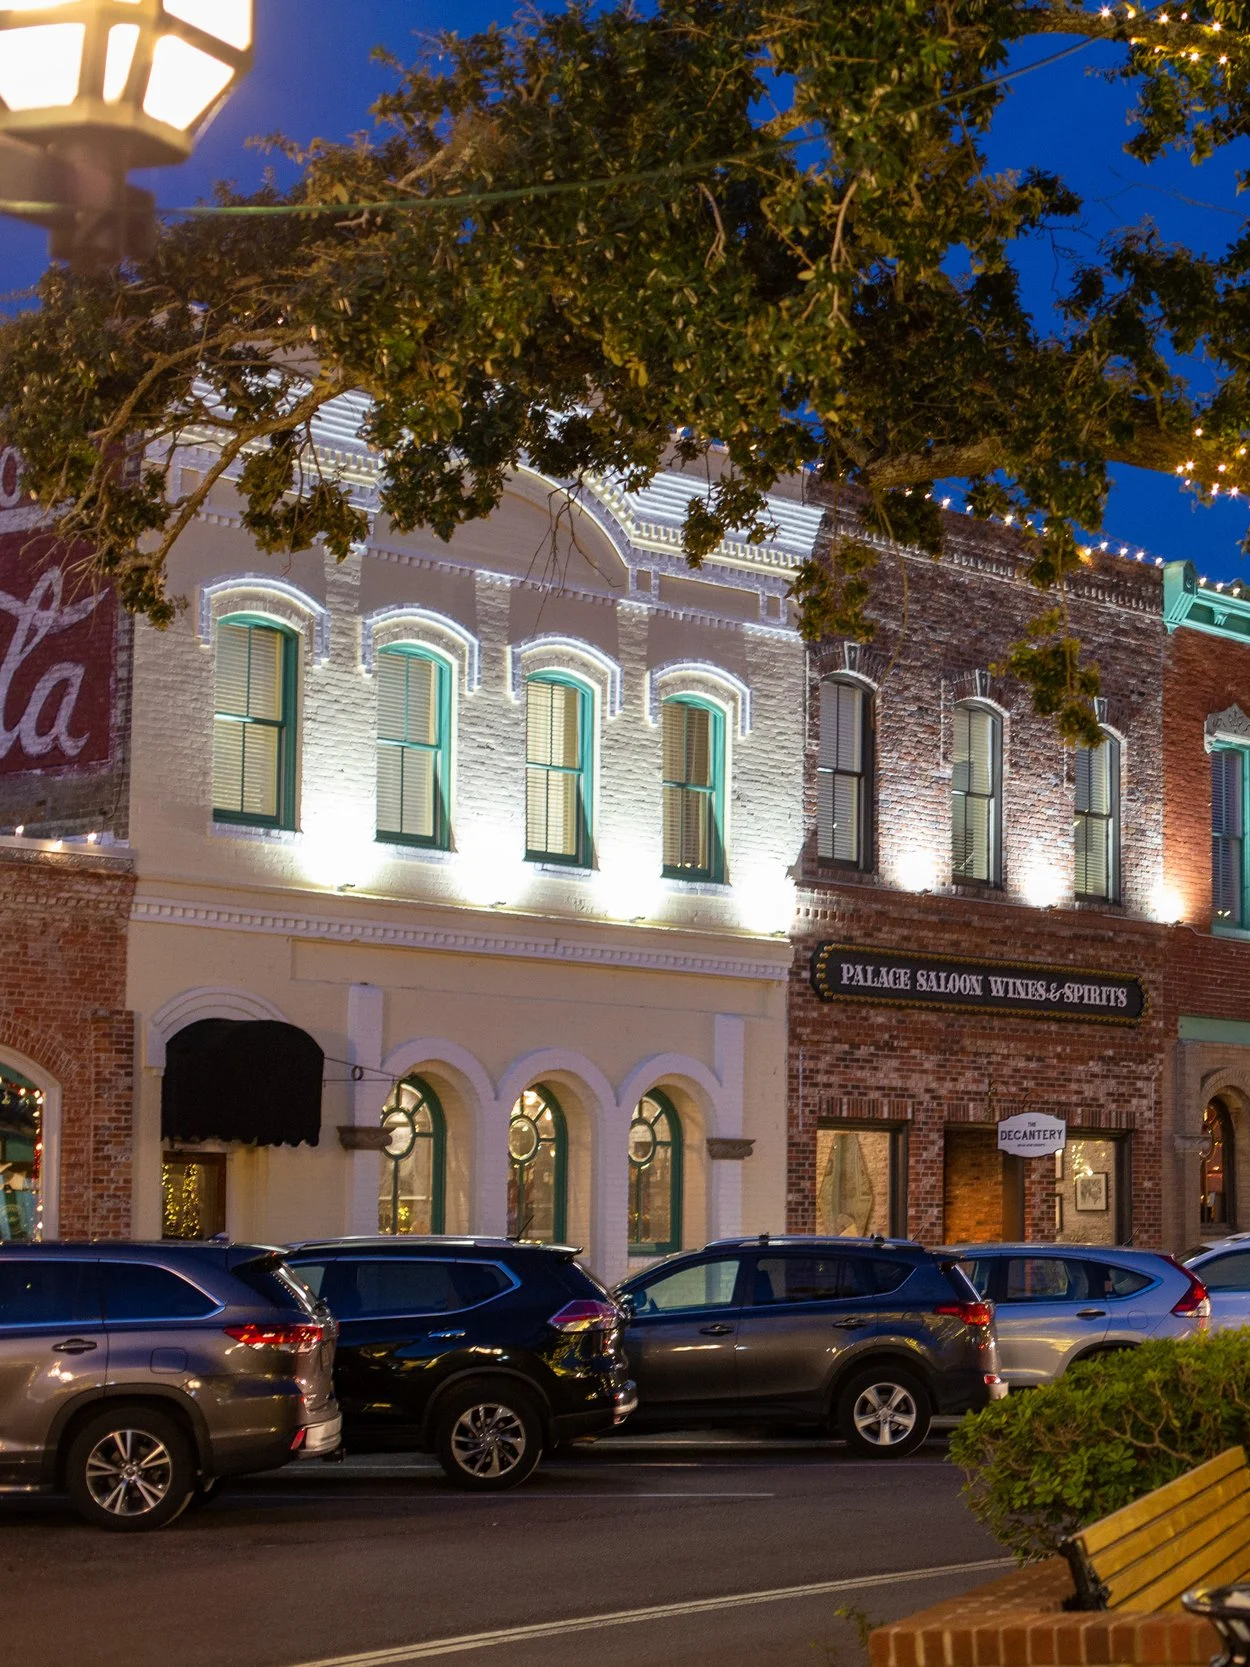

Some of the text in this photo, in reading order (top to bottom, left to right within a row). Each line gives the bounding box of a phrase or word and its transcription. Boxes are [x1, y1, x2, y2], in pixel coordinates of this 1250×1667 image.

[840, 963, 911, 990] PALACE
[916, 969, 983, 996] SALOON
[1000, 1128, 1063, 1140] DECANTERY
